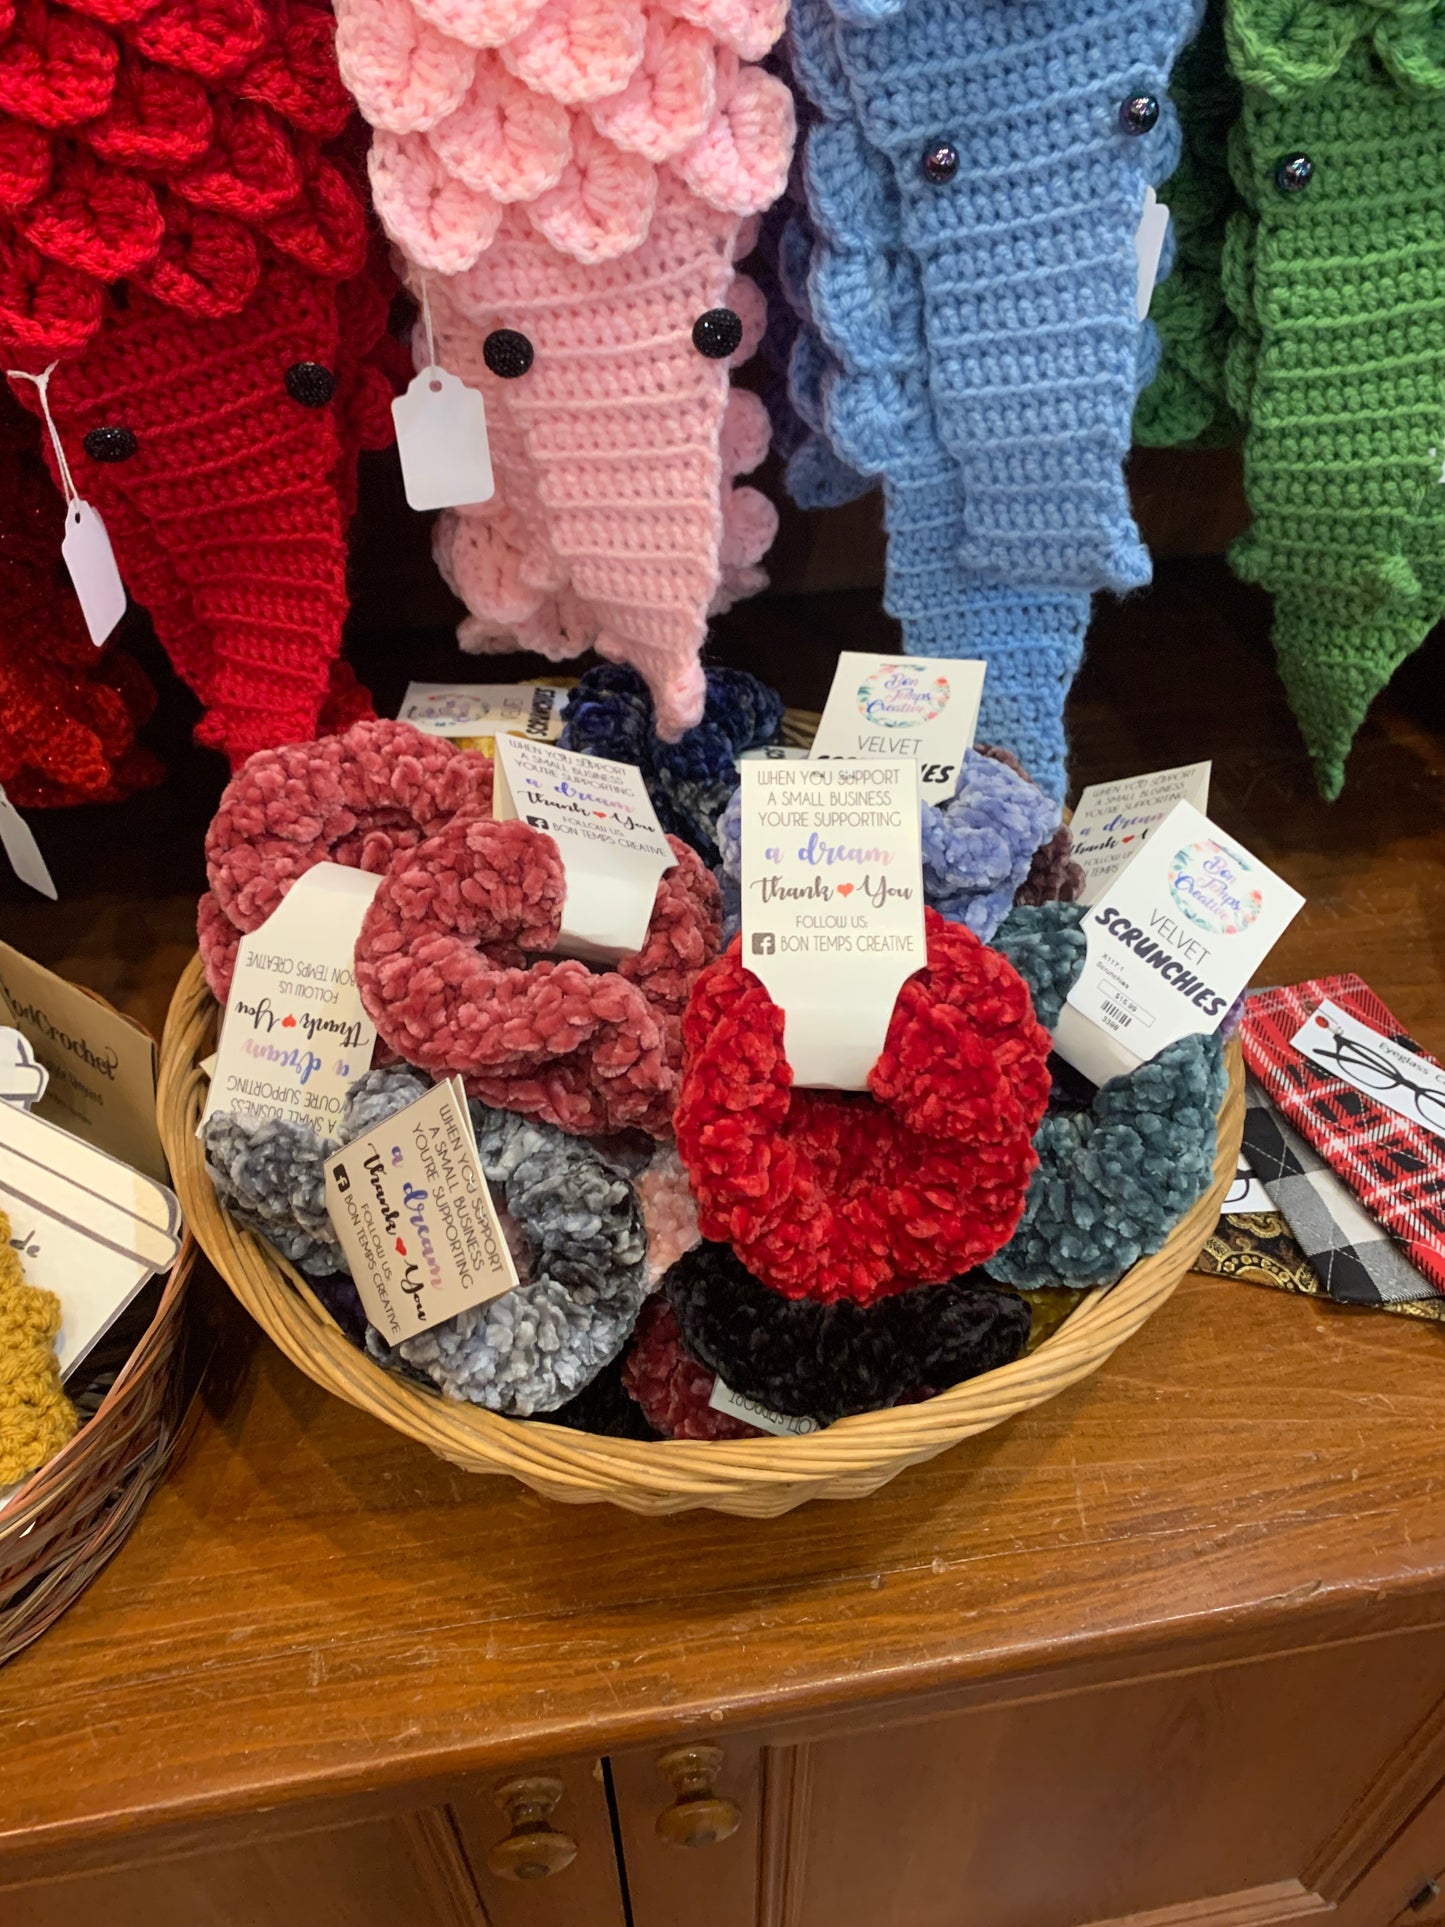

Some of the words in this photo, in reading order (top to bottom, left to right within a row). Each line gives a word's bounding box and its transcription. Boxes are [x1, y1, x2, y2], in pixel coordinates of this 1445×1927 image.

[867, 700, 924, 714] Creative
[509, 740, 542, 754] WHEN
[545, 748, 572, 764] YOU
[576, 755, 626, 775] SUPPORT
[858, 736, 923, 755] VELVET
[515, 760, 558, 778] YOU'RE
[562, 772, 635, 796] SUPPORTING
[521, 752, 529, 760] A
[532, 756, 568, 772] SMALL
[572, 765, 624, 785] BUSINESS
[758, 771, 795, 785] WHEN
[801, 771, 832, 785] YOU
[838, 769, 900, 785] SUPPORT
[526, 778, 542, 788] a
[554, 782, 634, 813] dream
[768, 792, 777, 806] A
[782, 792, 824, 806] SMALL
[830, 791, 891, 806] BUSINESS
[1106, 790, 1136, 804] SMALL
[563, 816, 607, 832] FOLLOW
[610, 813, 655, 832] You
[759, 812, 808, 826] YOU'RE
[814, 812, 901, 826] SUPPORTING
[552, 822, 579, 836] BON
[582, 829, 616, 845] TEMPS
[618, 839, 666, 856] CREATIVE
[766, 848, 782, 864] a
[798, 832, 893, 866] dream
[1202, 856, 1237, 885] Bon
[857, 875, 912, 908] You
[1174, 871, 1229, 920] Creative
[1196, 874, 1241, 911] Temps
[796, 916, 846, 928] FOLLOW
[1150, 908, 1211, 966] VELVET
[781, 936, 809, 951] BON
[814, 936, 852, 951] TEMPS
[857, 936, 913, 951] CREATIVE
[246, 951, 294, 974] CREATIVE
[297, 961, 329, 982] TEMPS
[1095, 907, 1227, 1016] SCRUNCHIES
[1096, 961, 1130, 990] Scrunchies
[295, 985, 339, 1004] FOLLOW
[235, 998, 280, 1032] You
[241, 1038, 321, 1085] dream
[335, 1059, 349, 1077] a
[1378, 1041, 1429, 1076] Eyeglass
[227, 1075, 302, 1100] SUPPORTING
[231, 1098, 283, 1121] BUSINESS
[328, 1120, 337, 1133] A
[429, 1127, 440, 1139] A
[435, 1142, 460, 1191] SMALL
[454, 1196, 484, 1271] BUSINESS
[439, 1106, 463, 1151] WHEN
[459, 1152, 476, 1193] YOU
[471, 1200, 503, 1272] SUPPORT
[392, 1146, 404, 1168] a
[403, 1182, 445, 1290] dream
[411, 1123, 440, 1182] YOU'RE
[432, 1186, 474, 1289] SUPPORTING
[361, 1203, 386, 1261] FOLLOW
[344, 1194, 359, 1226] BON
[356, 1229, 375, 1271] TEMPS
[374, 1272, 401, 1335] CREATIVE
[401, 1259, 427, 1322] You
